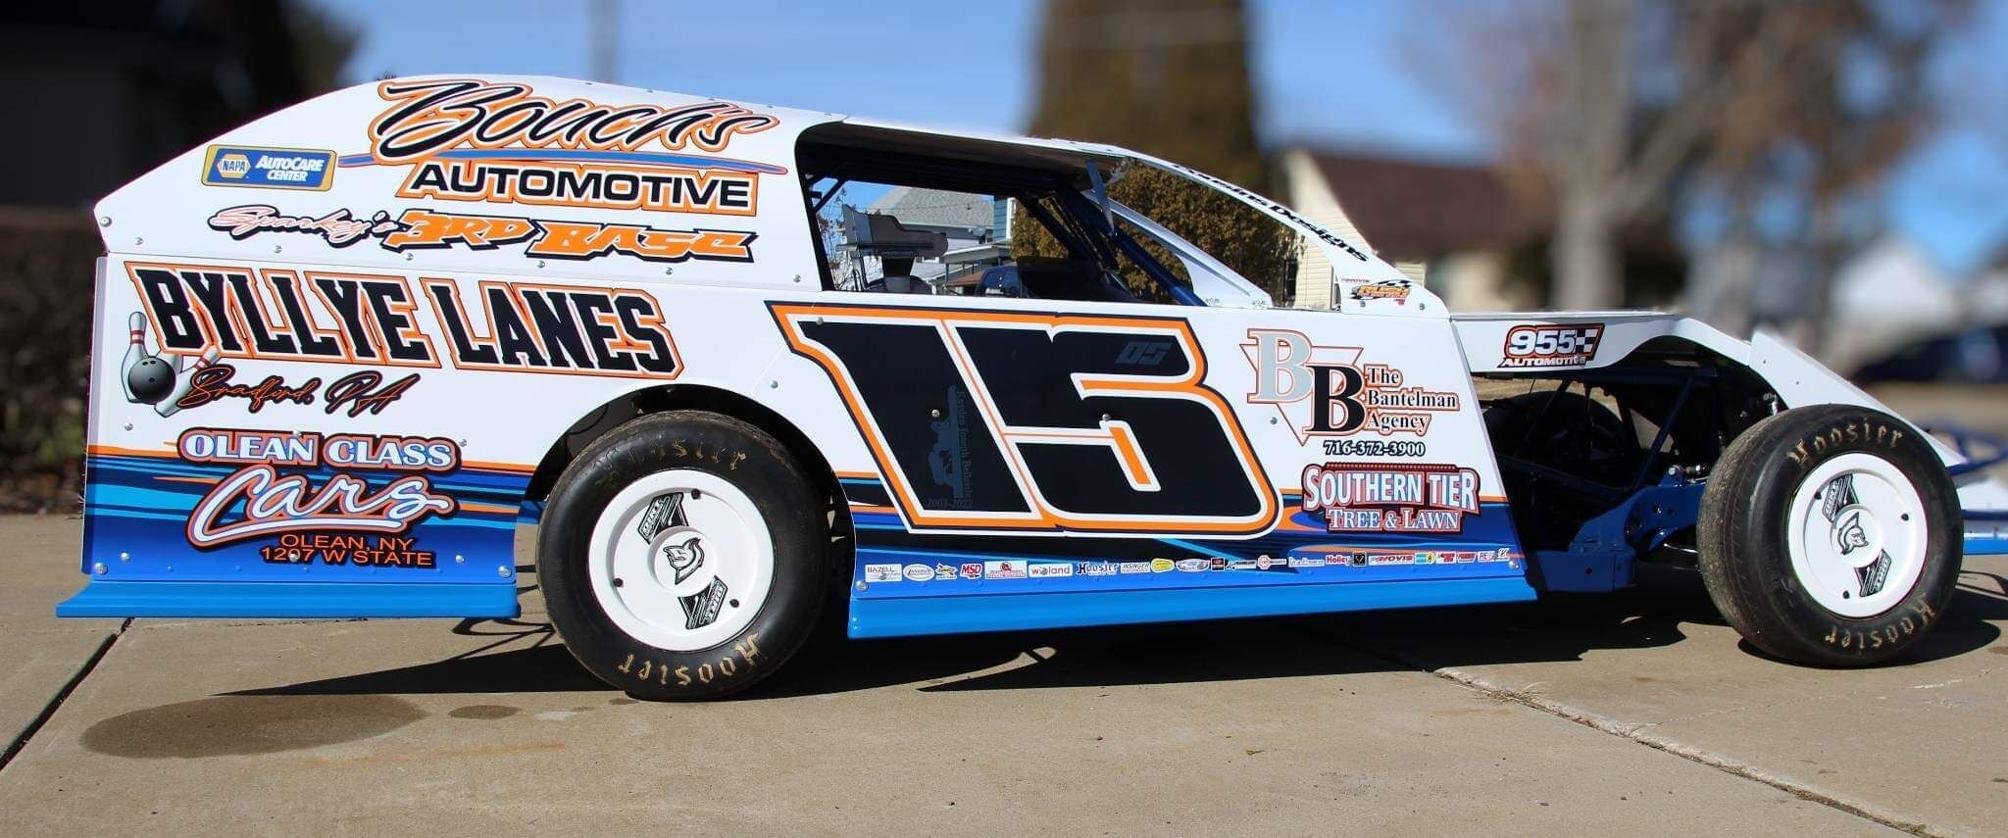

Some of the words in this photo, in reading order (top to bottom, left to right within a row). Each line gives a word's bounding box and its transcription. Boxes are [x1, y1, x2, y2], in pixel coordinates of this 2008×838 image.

[221, 159, 247, 173] NAPA
[266, 169, 309, 182] CENTER
[410, 163, 750, 208] AUTOMOTIVE
[384, 210, 531, 250] 3RD
[1269, 205, 1368, 262] Designs
[130, 266, 440, 365] BYLLYE
[423, 280, 681, 376] LANES
[1115, 341, 1173, 365] 05
[1507, 328, 1577, 355] 955
[1367, 366, 1400, 386] The
[1367, 388, 1457, 408] Bantelman
[785, 312, 1274, 526] 15
[1367, 413, 1430, 435] Agency
[184, 433, 317, 462] OLEAN
[326, 439, 454, 468] CLASS
[1323, 440, 1426, 456] 716-372-3900
[1302, 466, 1423, 508] SOUTHERN
[1428, 470, 1479, 512] TIER
[192, 467, 451, 542] Cars
[1328, 508, 1381, 529] TREE
[1385, 512, 1398, 528] &
[1402, 510, 1461, 530] LAWN
[281, 534, 371, 551] OLEAN,
[379, 538, 414, 551] NY
[322, 549, 346, 562] W
[353, 550, 433, 566] STATE
[962, 564, 981, 574] MSD
[617, 631, 761, 687] Hoosier
